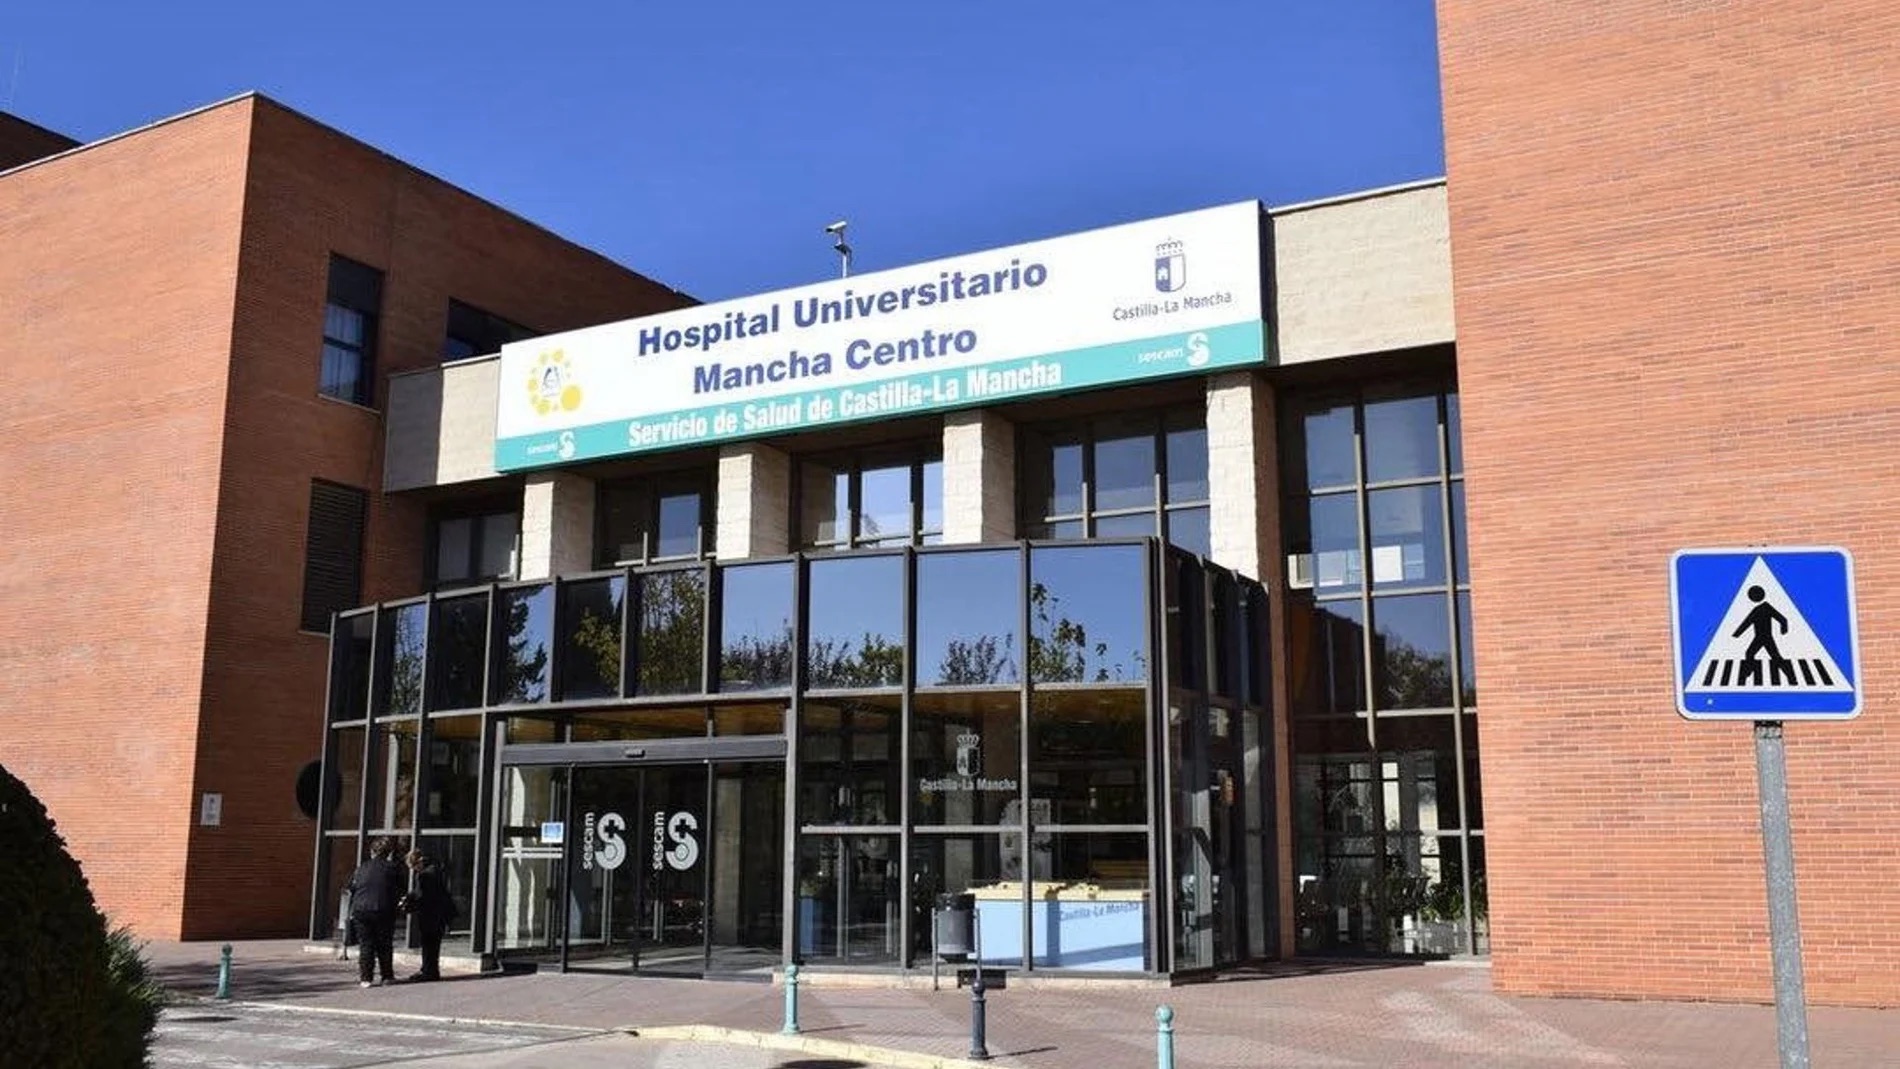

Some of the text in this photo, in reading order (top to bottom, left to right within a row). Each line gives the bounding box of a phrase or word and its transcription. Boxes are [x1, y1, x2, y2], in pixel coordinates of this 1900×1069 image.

[638, 259, 1048, 356] Hospital Universitario
[1112, 291, 1233, 321] Castilla-La Mancha
[693, 329, 977, 394] Mancha Centro
[627, 360, 1063, 447] Servicio de Salud de Castilla-La Mancha
[919, 777, 1018, 793] Castilla-La Mancha
[582, 811, 596, 870] sescam
[652, 811, 666, 870] sescam
